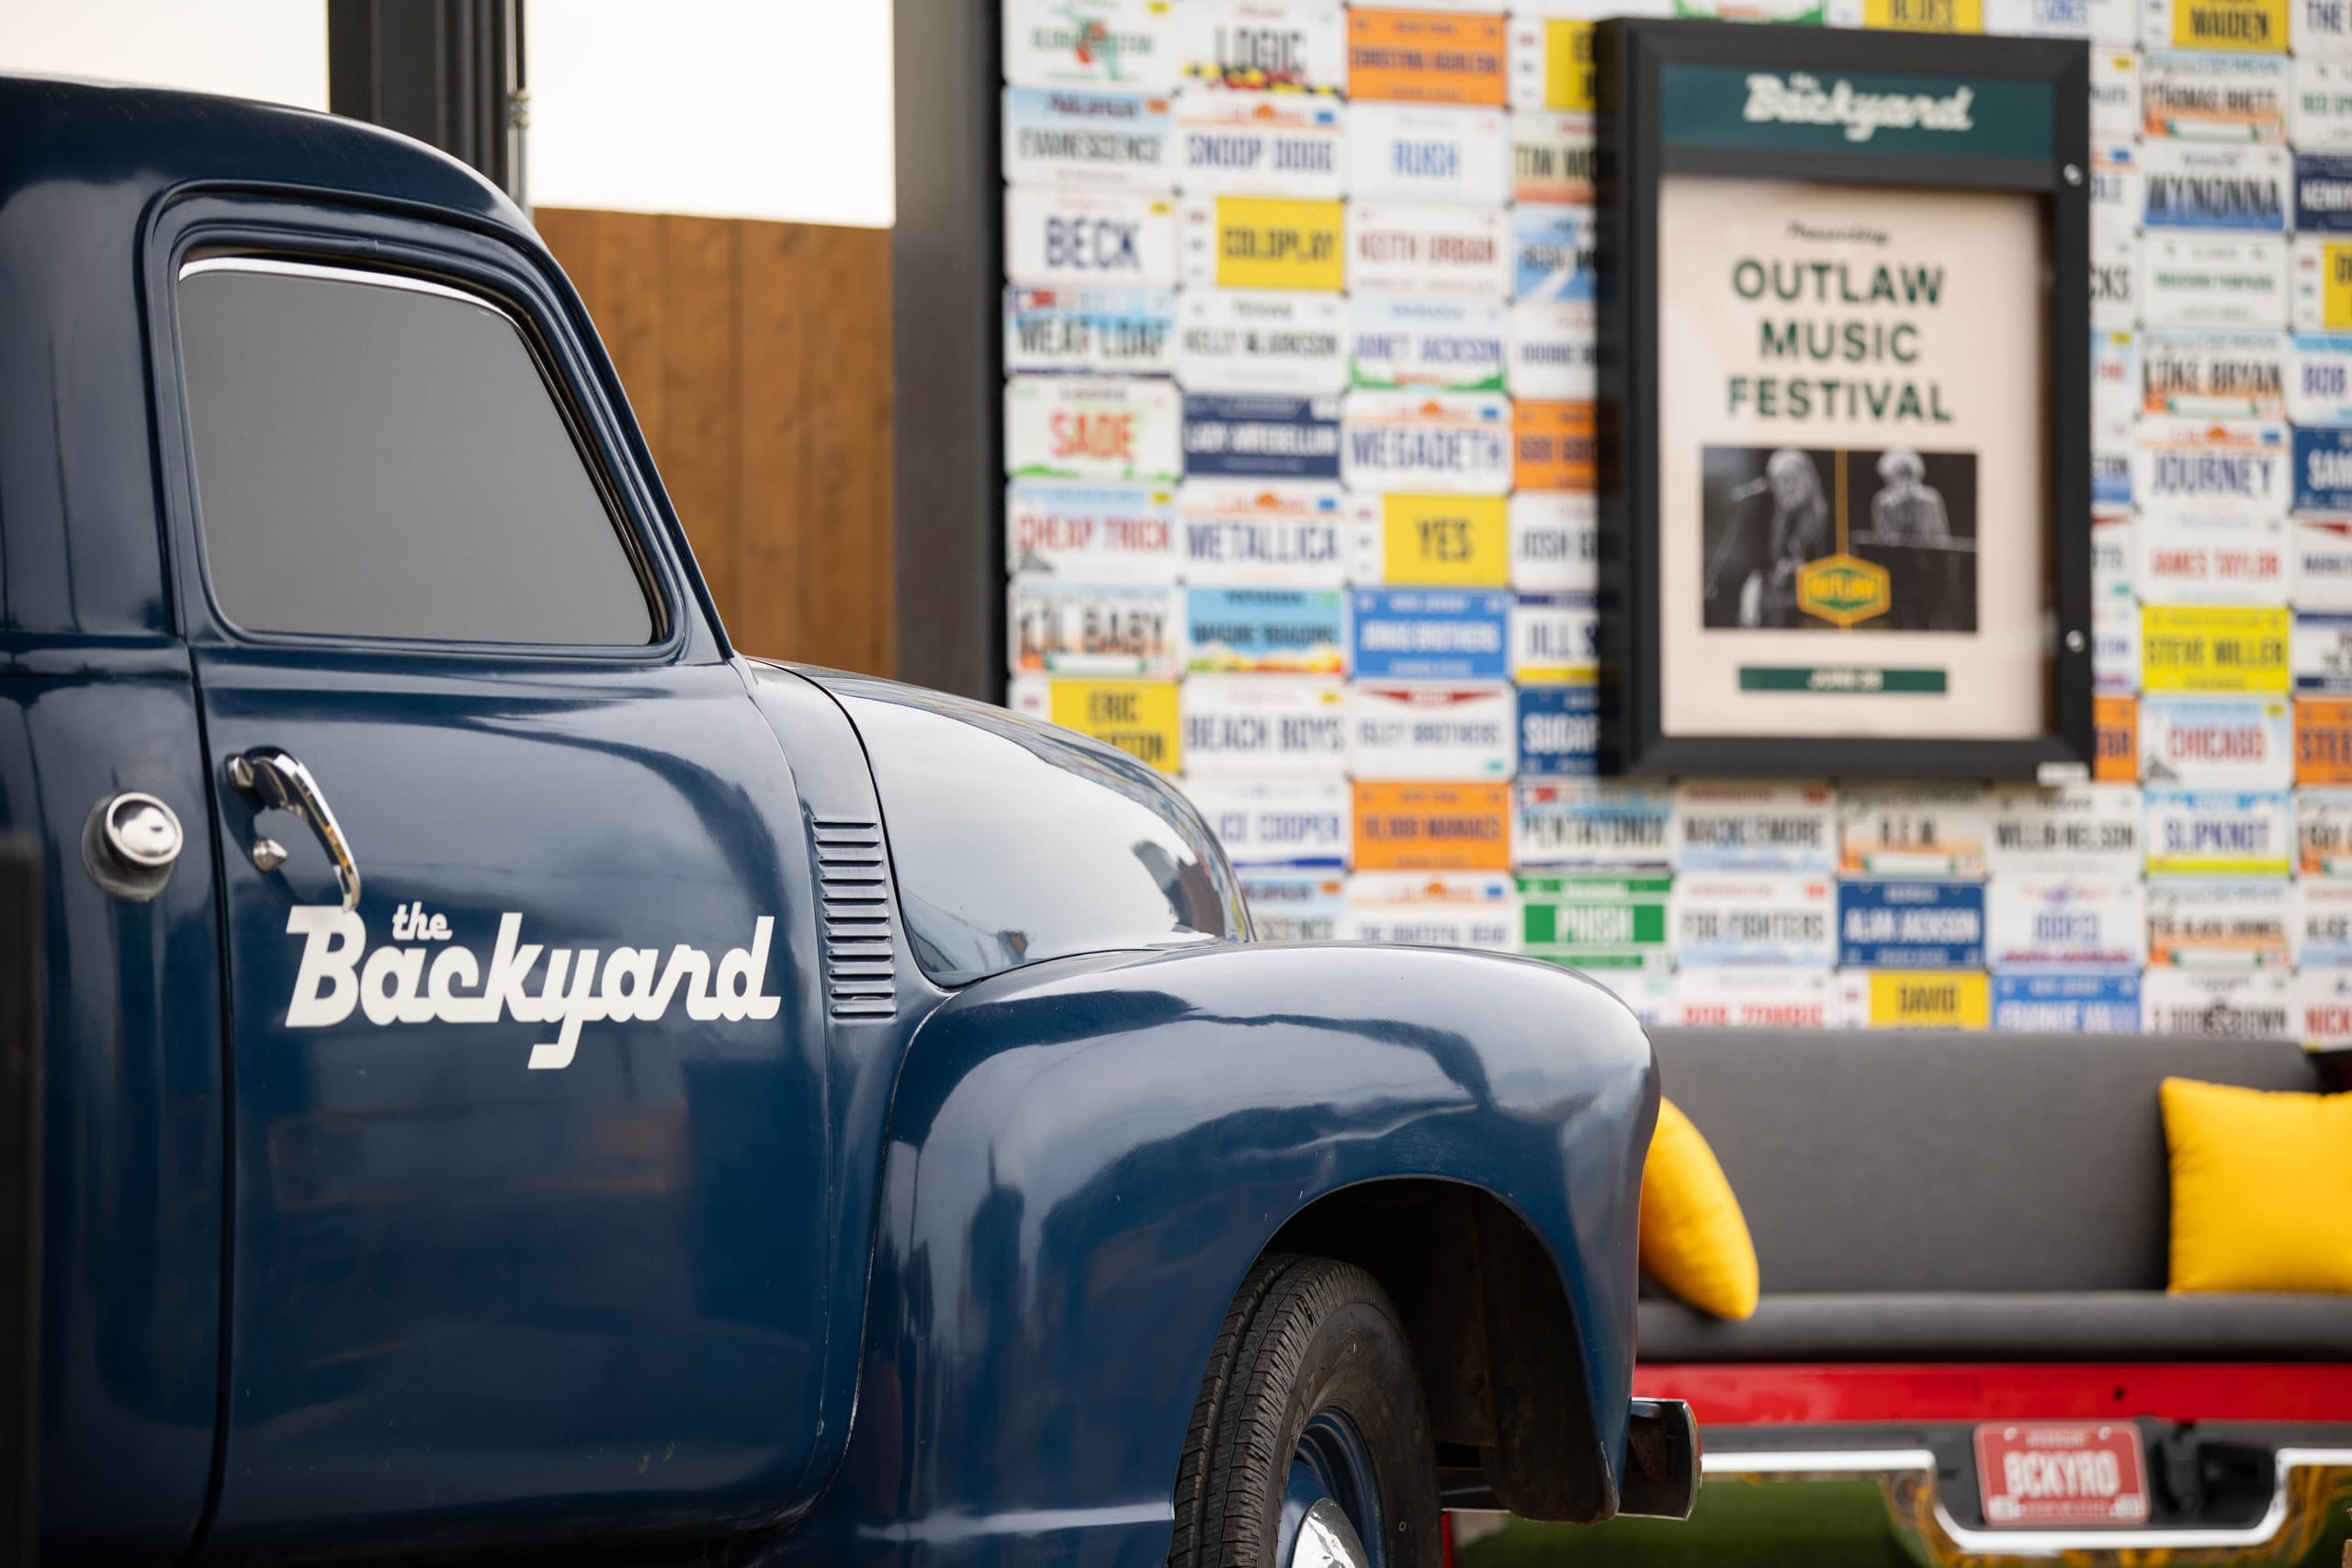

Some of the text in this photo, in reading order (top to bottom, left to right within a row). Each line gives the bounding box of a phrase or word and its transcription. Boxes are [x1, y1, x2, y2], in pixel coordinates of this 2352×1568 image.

[1216, 27, 1306, 73] LOGIC
[1744, 73, 1973, 141] Backyard
[1018, 128, 1161, 164] EVANESCENCE
[1185, 133, 1336, 170] SNOOP DOGG
[1391, 138, 1461, 177] RUSH
[1045, 215, 1142, 270] BECK
[1223, 227, 1336, 264] COLDPLAY
[1357, 233, 1497, 265] KEITH URBAN
[1733, 259, 1944, 307] OUTLAW
[1759, 318, 1919, 363] MUSIC
[1727, 376, 1953, 423] FESTIVAL
[2302, 366, 2346, 396] BOB
[1050, 412, 1136, 461] SADE
[1351, 426, 1503, 472] MEGADETH
[2152, 453, 2273, 496] JOURNEY
[1017, 516, 1170, 552] CHEAP TRICK
[1186, 520, 1340, 564] METALLICA
[1416, 516, 1475, 563] YES
[2153, 550, 2207, 576] JAMES
[2215, 552, 2279, 579] TAYLOR
[2146, 636, 2207, 667] STEVE
[2213, 638, 2283, 669] MILLER
[1089, 692, 1141, 723] ERIC
[1186, 716, 1342, 753] BEACH BOYS
[2169, 726, 2267, 761] CHICAGO
[1258, 812, 1341, 844] COOPER
[2165, 819, 2271, 852] SLIPKNOT
[391, 901, 453, 941] the
[1555, 904, 1633, 942] PHISH
[1901, 908, 1980, 944] JACKSON
[285, 905, 782, 1069] Backyard
[1898, 985, 1959, 1016] DAVID
[2004, 1450, 2120, 1498] BCKYRD
